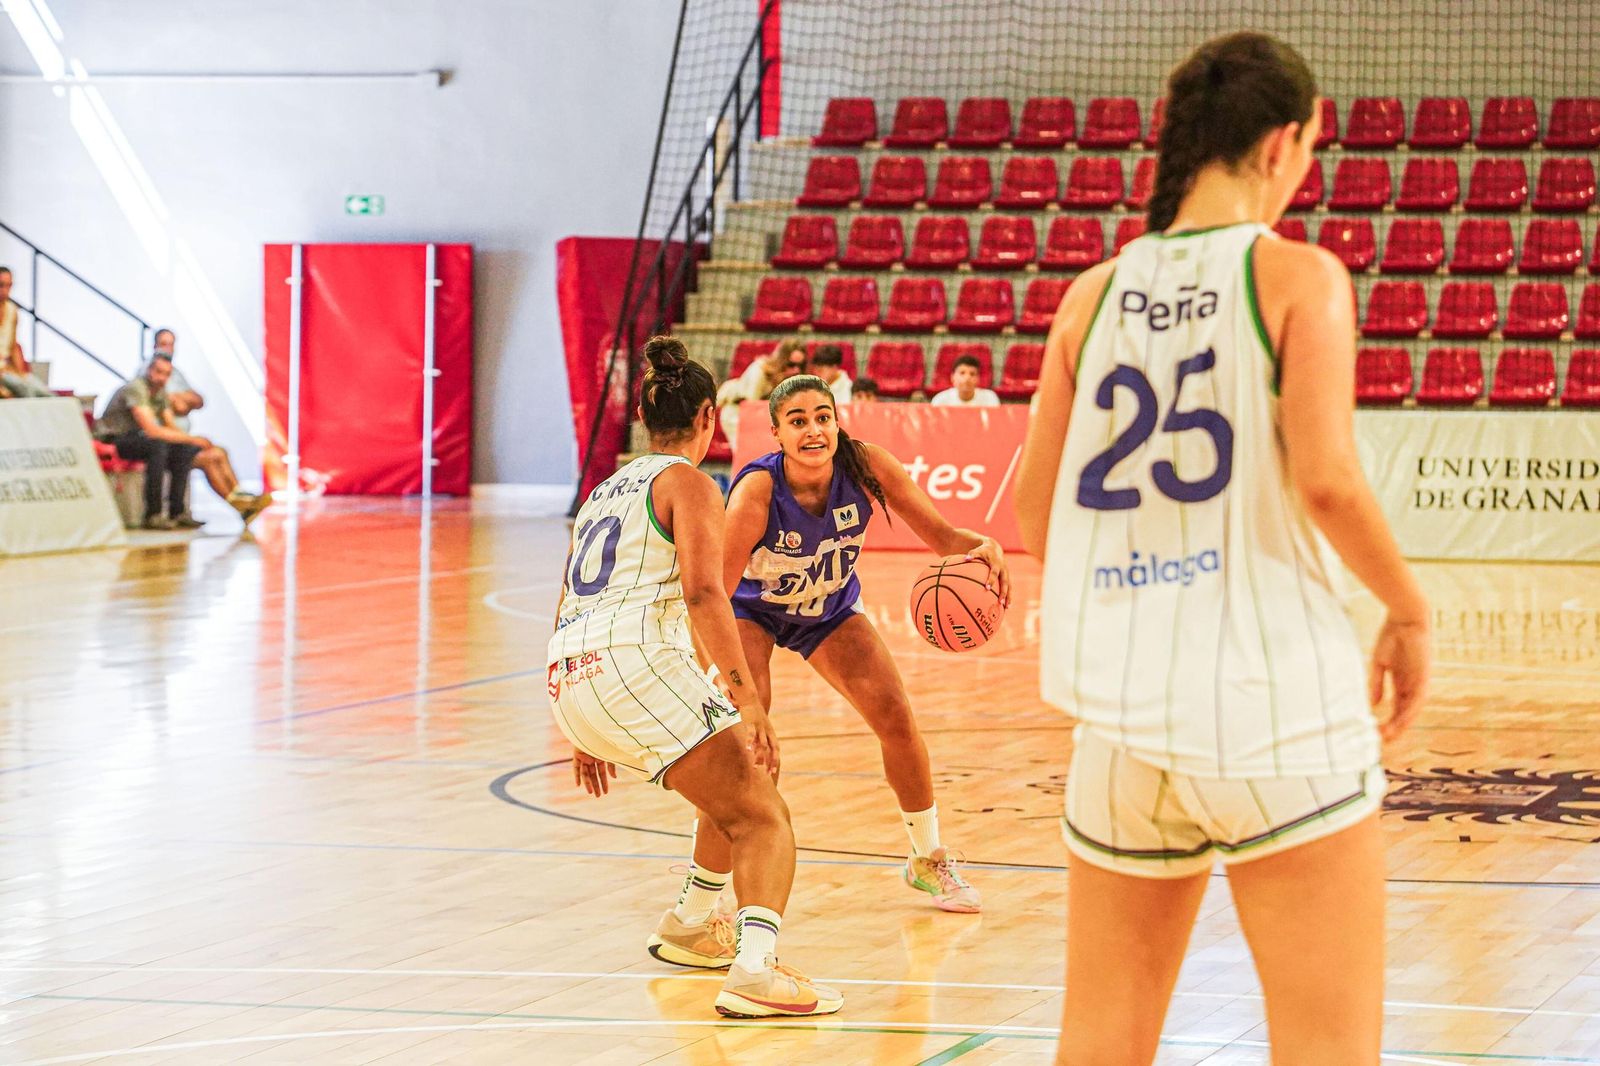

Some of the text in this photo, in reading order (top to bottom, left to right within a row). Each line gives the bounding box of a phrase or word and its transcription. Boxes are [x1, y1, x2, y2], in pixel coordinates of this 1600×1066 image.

[1120, 284, 1218, 331] Peña
[1076, 347, 1234, 511] 25
[1417, 456, 1600, 480] UNIVERSID
[1414, 486, 1600, 512] DE GRANA
[580, 650, 603, 668] SOL
